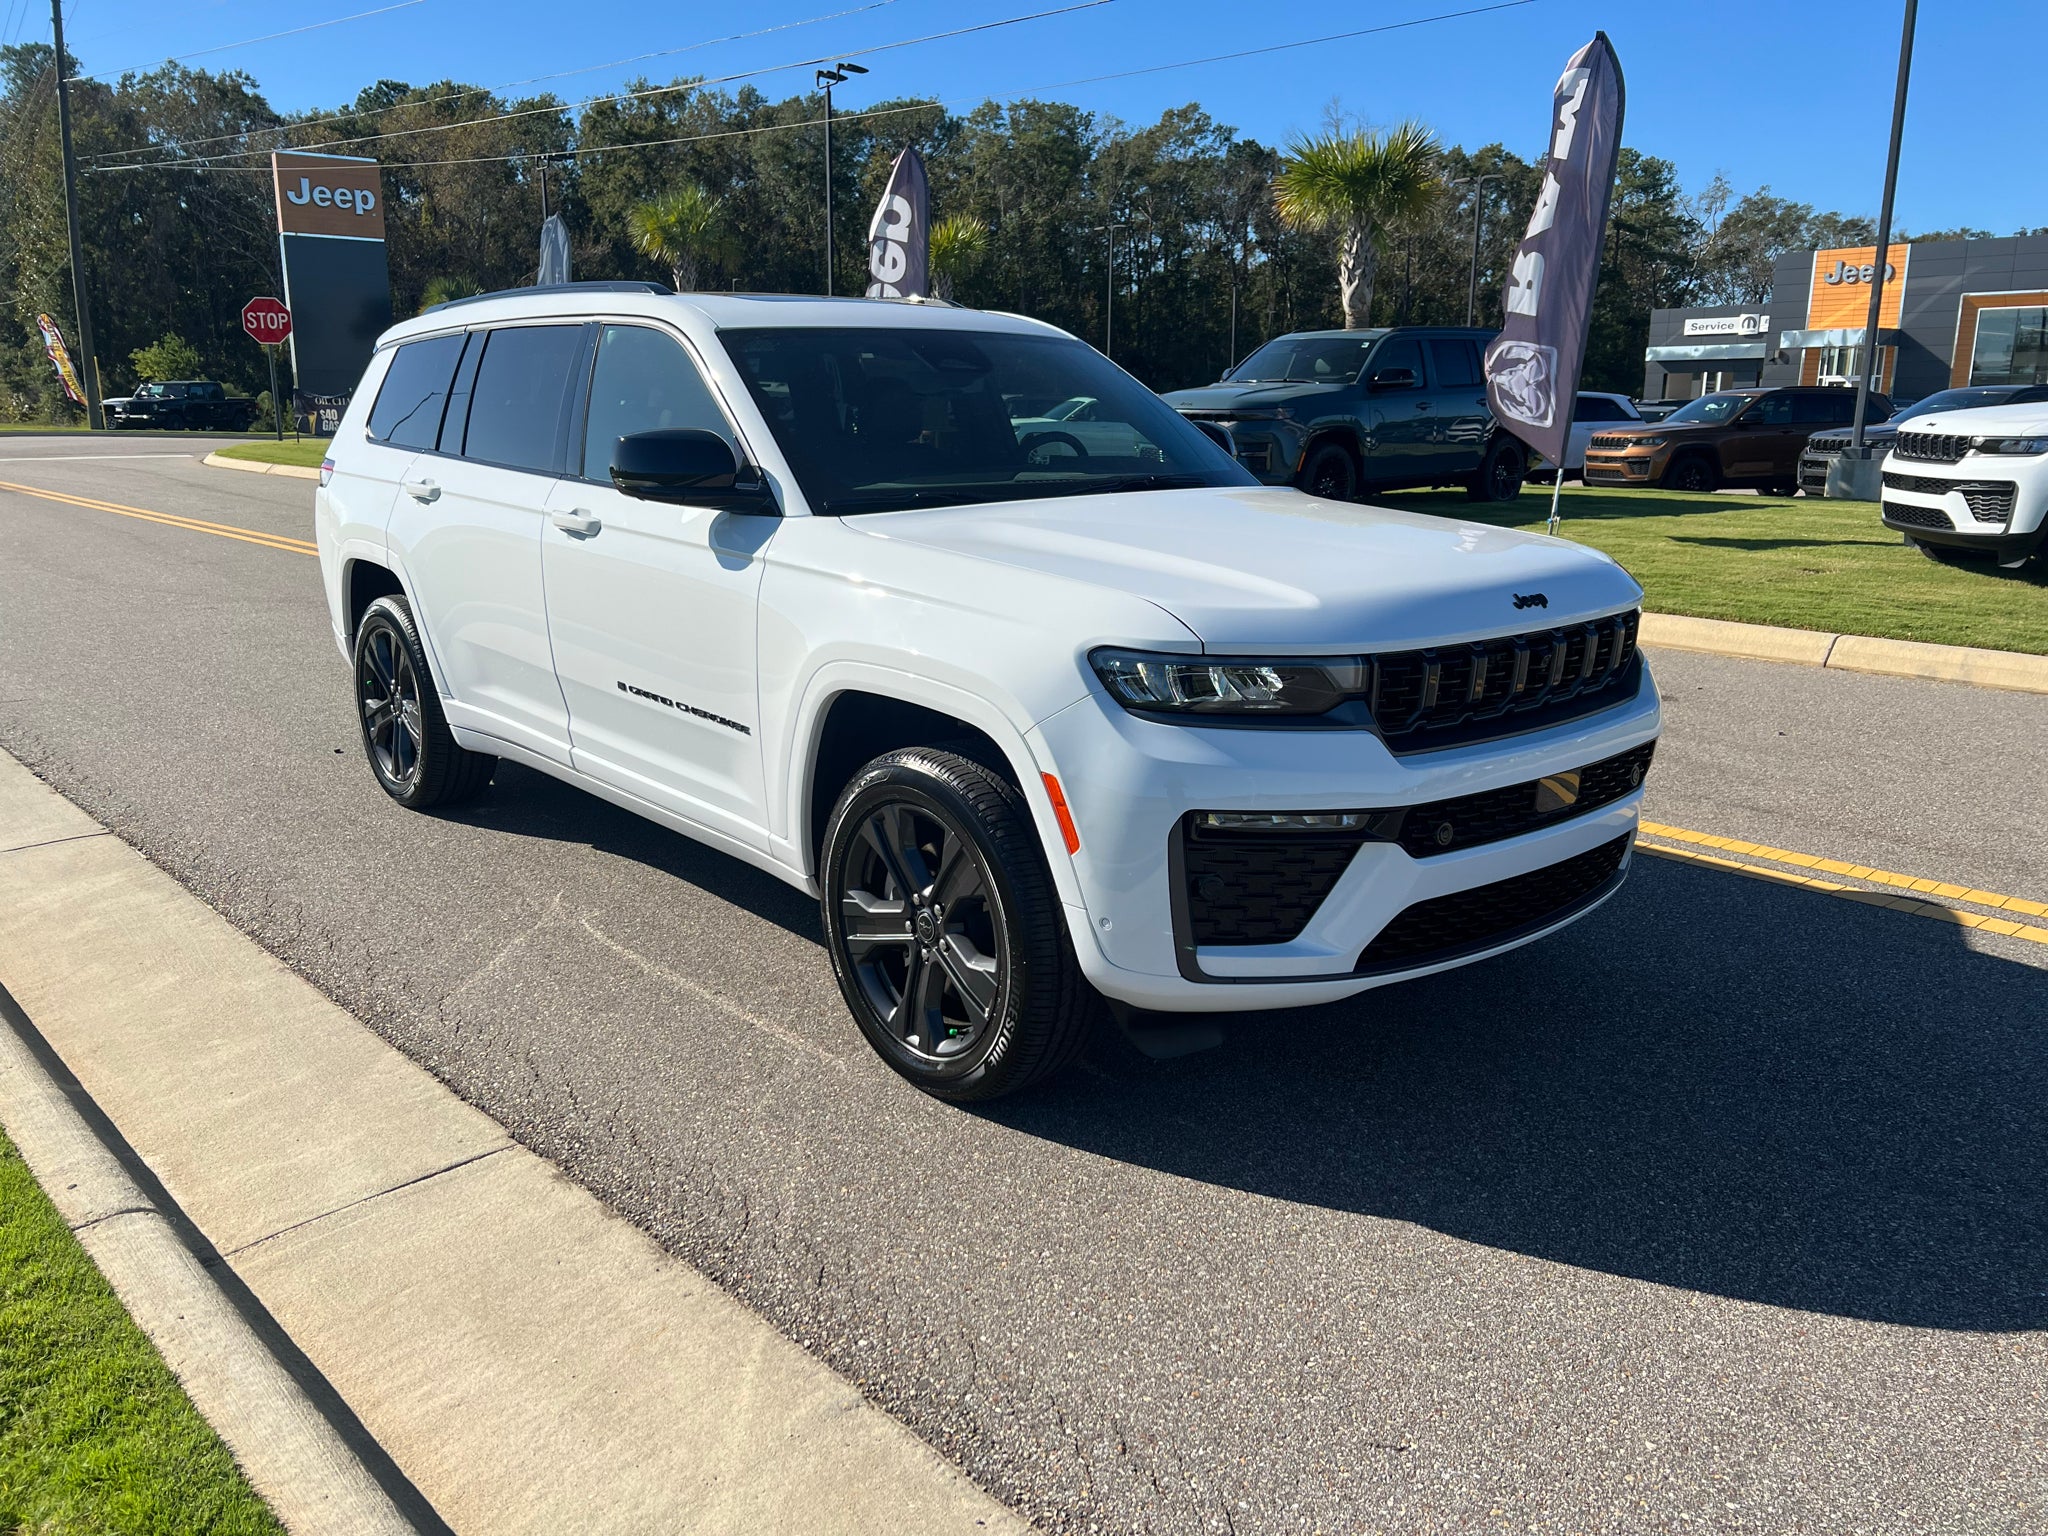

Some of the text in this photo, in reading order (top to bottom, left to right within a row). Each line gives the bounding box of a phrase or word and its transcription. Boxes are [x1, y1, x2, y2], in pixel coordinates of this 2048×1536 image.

[286, 177, 376, 215] Jeep
[246, 311, 289, 330] STOP
[1690, 321, 1735, 332] Service
[314, 397, 331, 406] OIL
[319, 408, 338, 420] $40
[322, 420, 340, 432] GAS
[1512, 592, 1549, 610] Jeep
[628, 685, 752, 737] GRAND CHEROKEE
